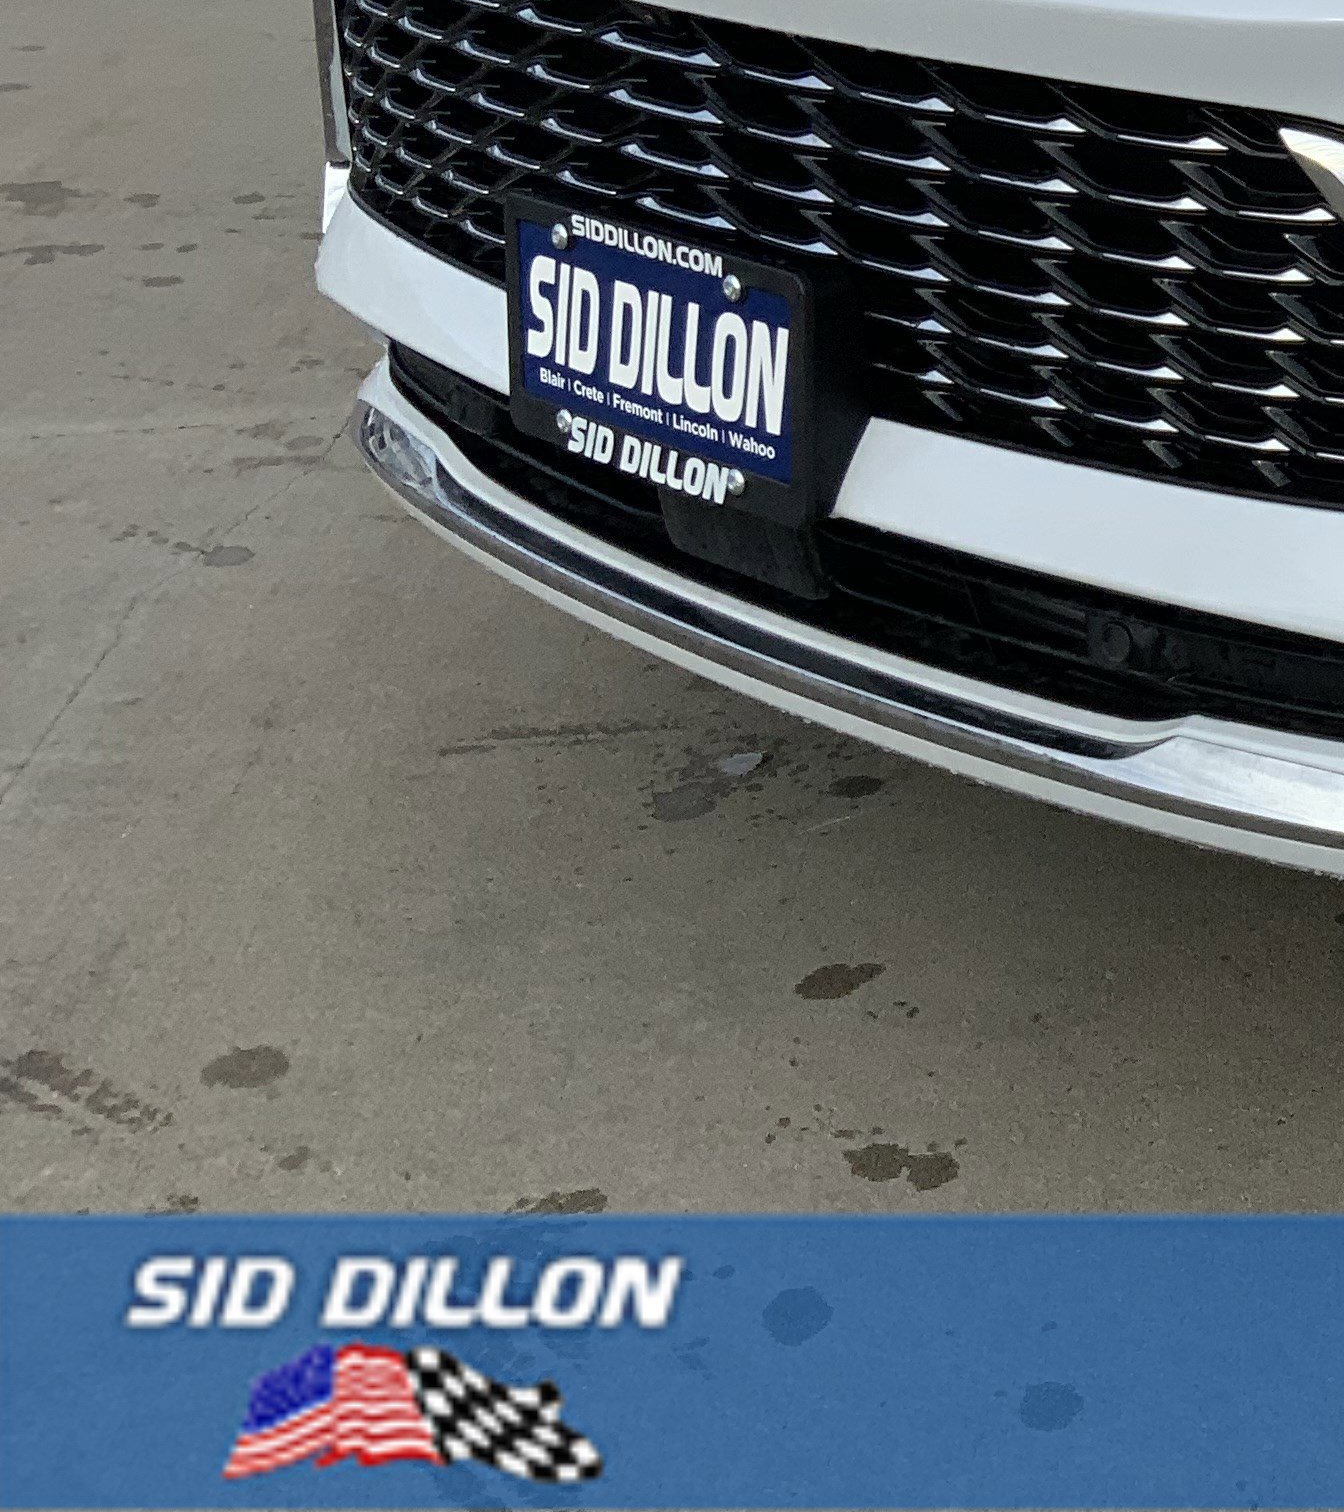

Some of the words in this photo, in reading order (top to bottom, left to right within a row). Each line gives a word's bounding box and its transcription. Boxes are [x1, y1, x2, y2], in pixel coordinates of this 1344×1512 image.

[570, 213, 723, 278] SIDDILLON.COM
[527, 254, 600, 376] SID
[609, 279, 790, 436] DILLON
[539, 366, 566, 390] Blair
[572, 380, 605, 405] Crete
[612, 392, 664, 425] Fremont
[672, 414, 719, 442] Lincoln
[728, 430, 777, 461] Wahoo
[567, 415, 615, 466] SID
[619, 433, 731, 506] DILLON
